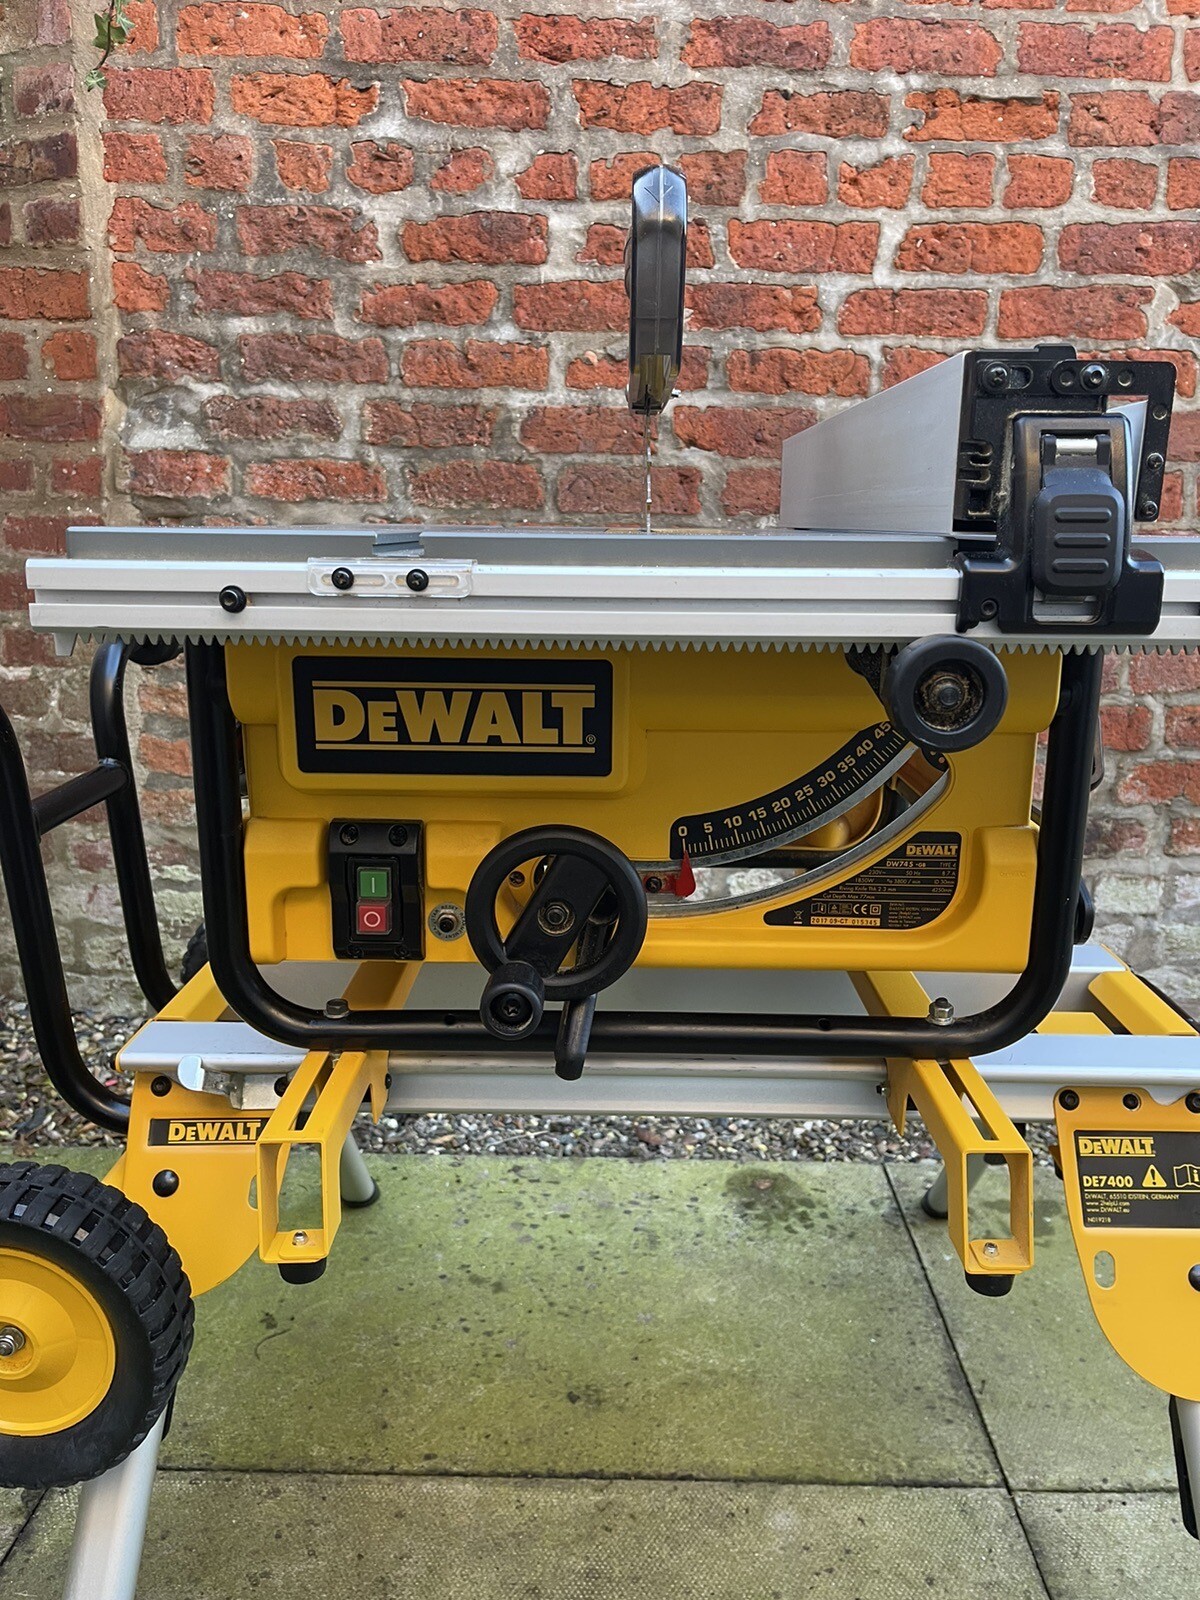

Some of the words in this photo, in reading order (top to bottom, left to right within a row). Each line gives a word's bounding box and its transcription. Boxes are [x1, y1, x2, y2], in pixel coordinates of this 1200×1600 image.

[312, 689, 596, 745] DEWALT
[677, 826, 688, 837] 0
[703, 822, 714, 834] 5
[723, 815, 742, 829] 10
[748, 807, 767, 822] 15
[771, 797, 791, 814] 20
[794, 784, 814, 801] 25
[816, 770, 837, 788] 30
[837, 754, 856, 774] 35
[855, 739, 874, 757] 40
[874, 721, 892, 740] 45
[168, 1122, 261, 1141] DEWALT
[1078, 1139, 1154, 1155] DEWALT
[1082, 1175, 1134, 1188] DE7400
